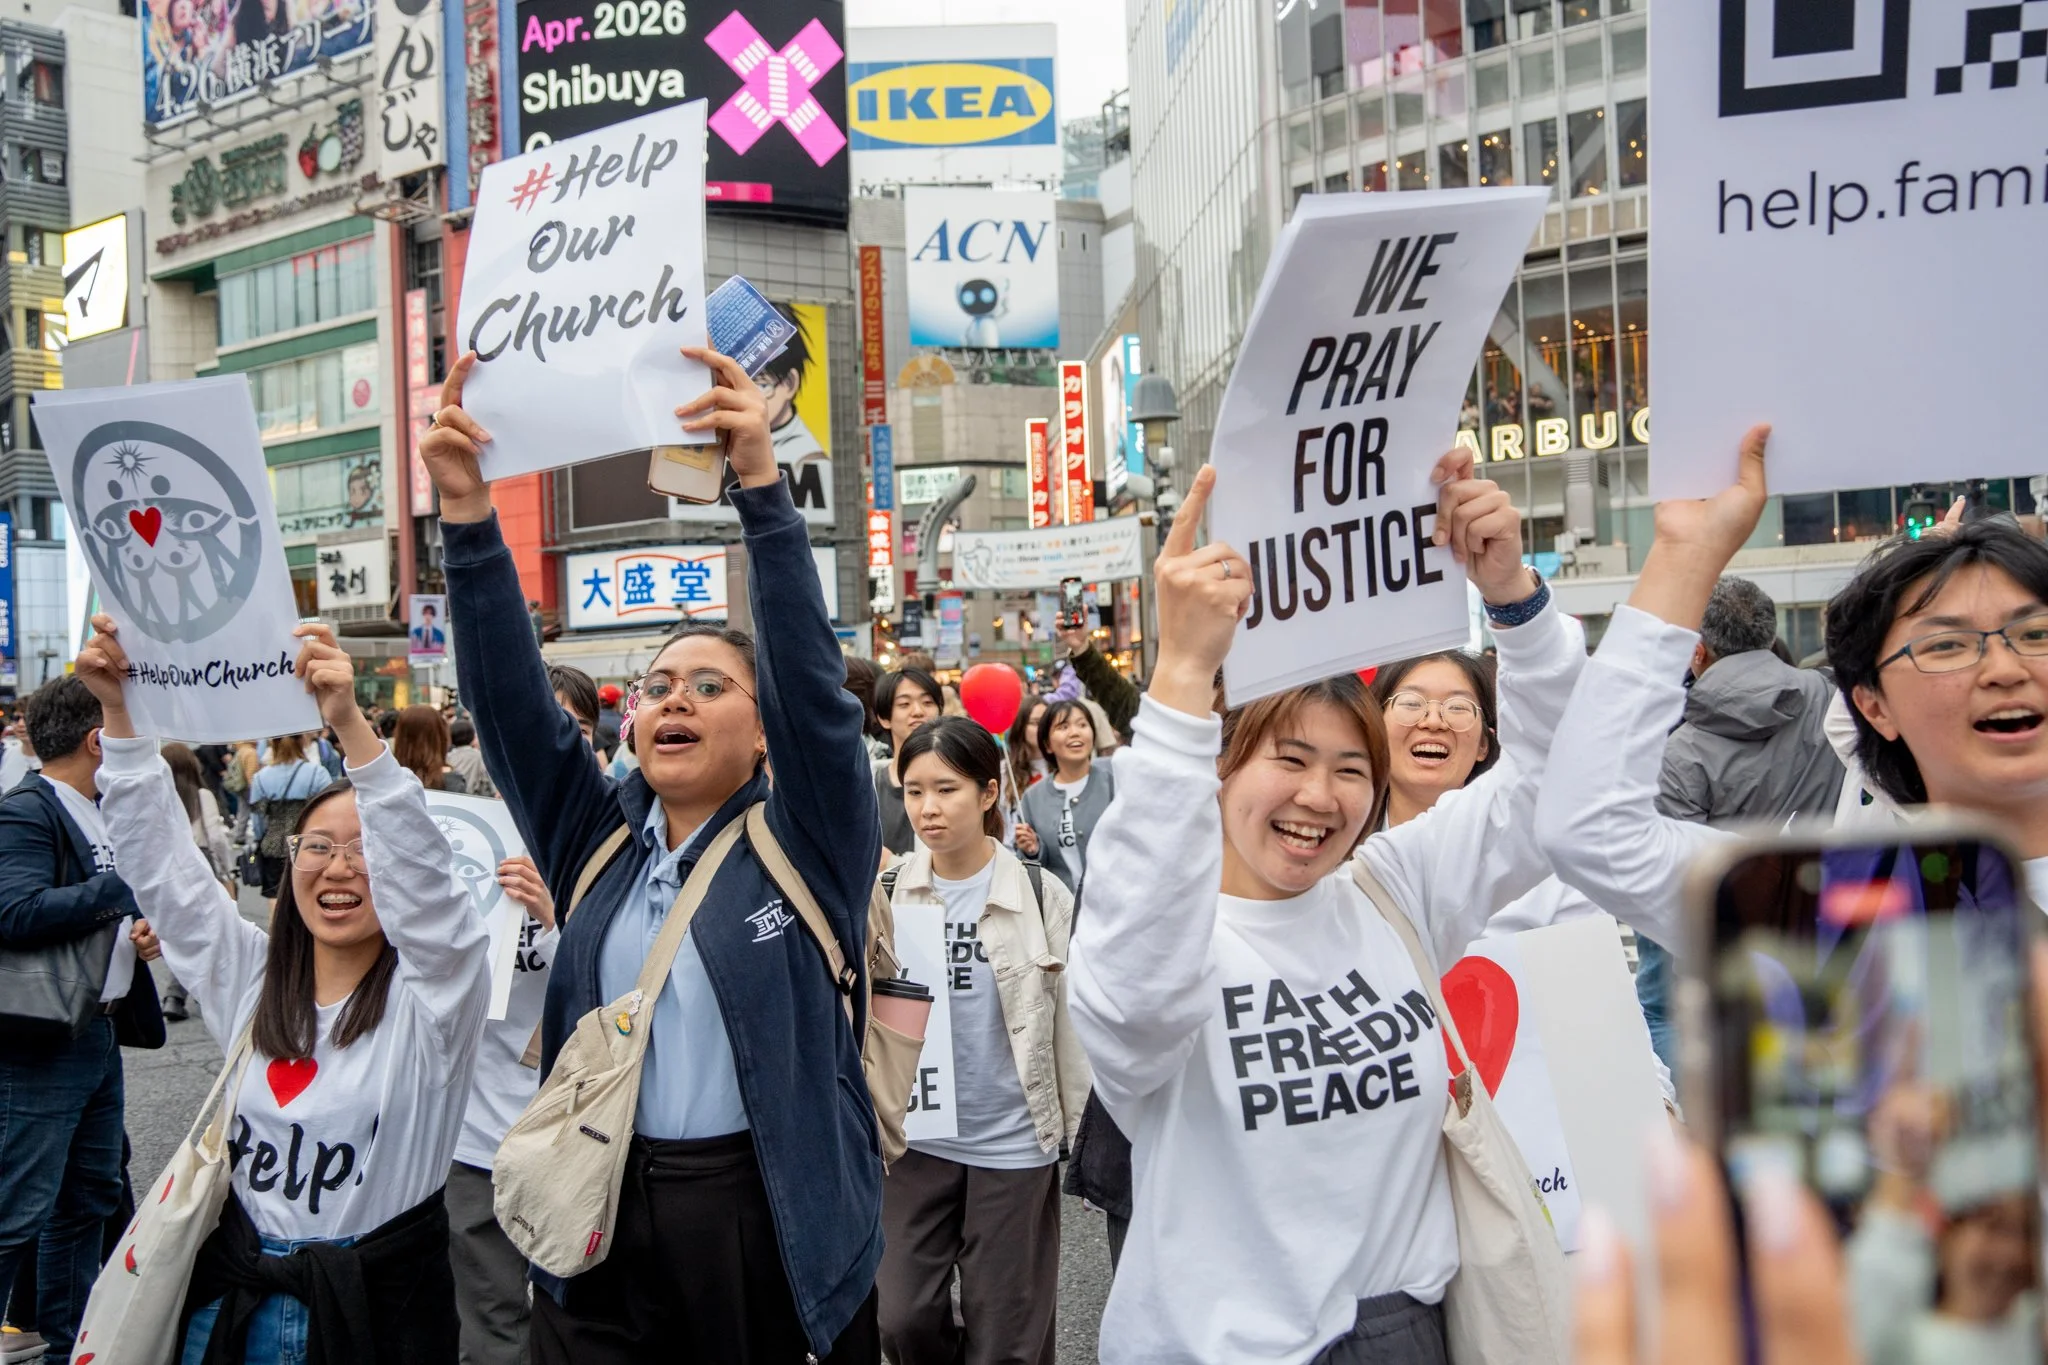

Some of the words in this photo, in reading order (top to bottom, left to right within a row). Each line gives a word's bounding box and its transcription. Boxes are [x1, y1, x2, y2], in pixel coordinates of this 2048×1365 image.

[522, 14, 591, 54] Apr.
[593, 0, 687, 40] 2026
[522, 63, 686, 114] Shibuya
[857, 85, 1037, 121] IKEA
[507, 133, 678, 214] #Help
[527, 214, 635, 274] Our
[911, 217, 1051, 263] ACN
[1353, 232, 1459, 318] WE
[468, 264, 688, 363] Church
[1286, 321, 1442, 416] PRAY
[1295, 417, 1389, 514] FOR
[582, 561, 711, 610] 大盛堂
[1245, 503, 1444, 630] JUSTICE
[127, 651, 295, 691] #HelpOurChurch
[1239, 1053, 1421, 1131] PEACE
